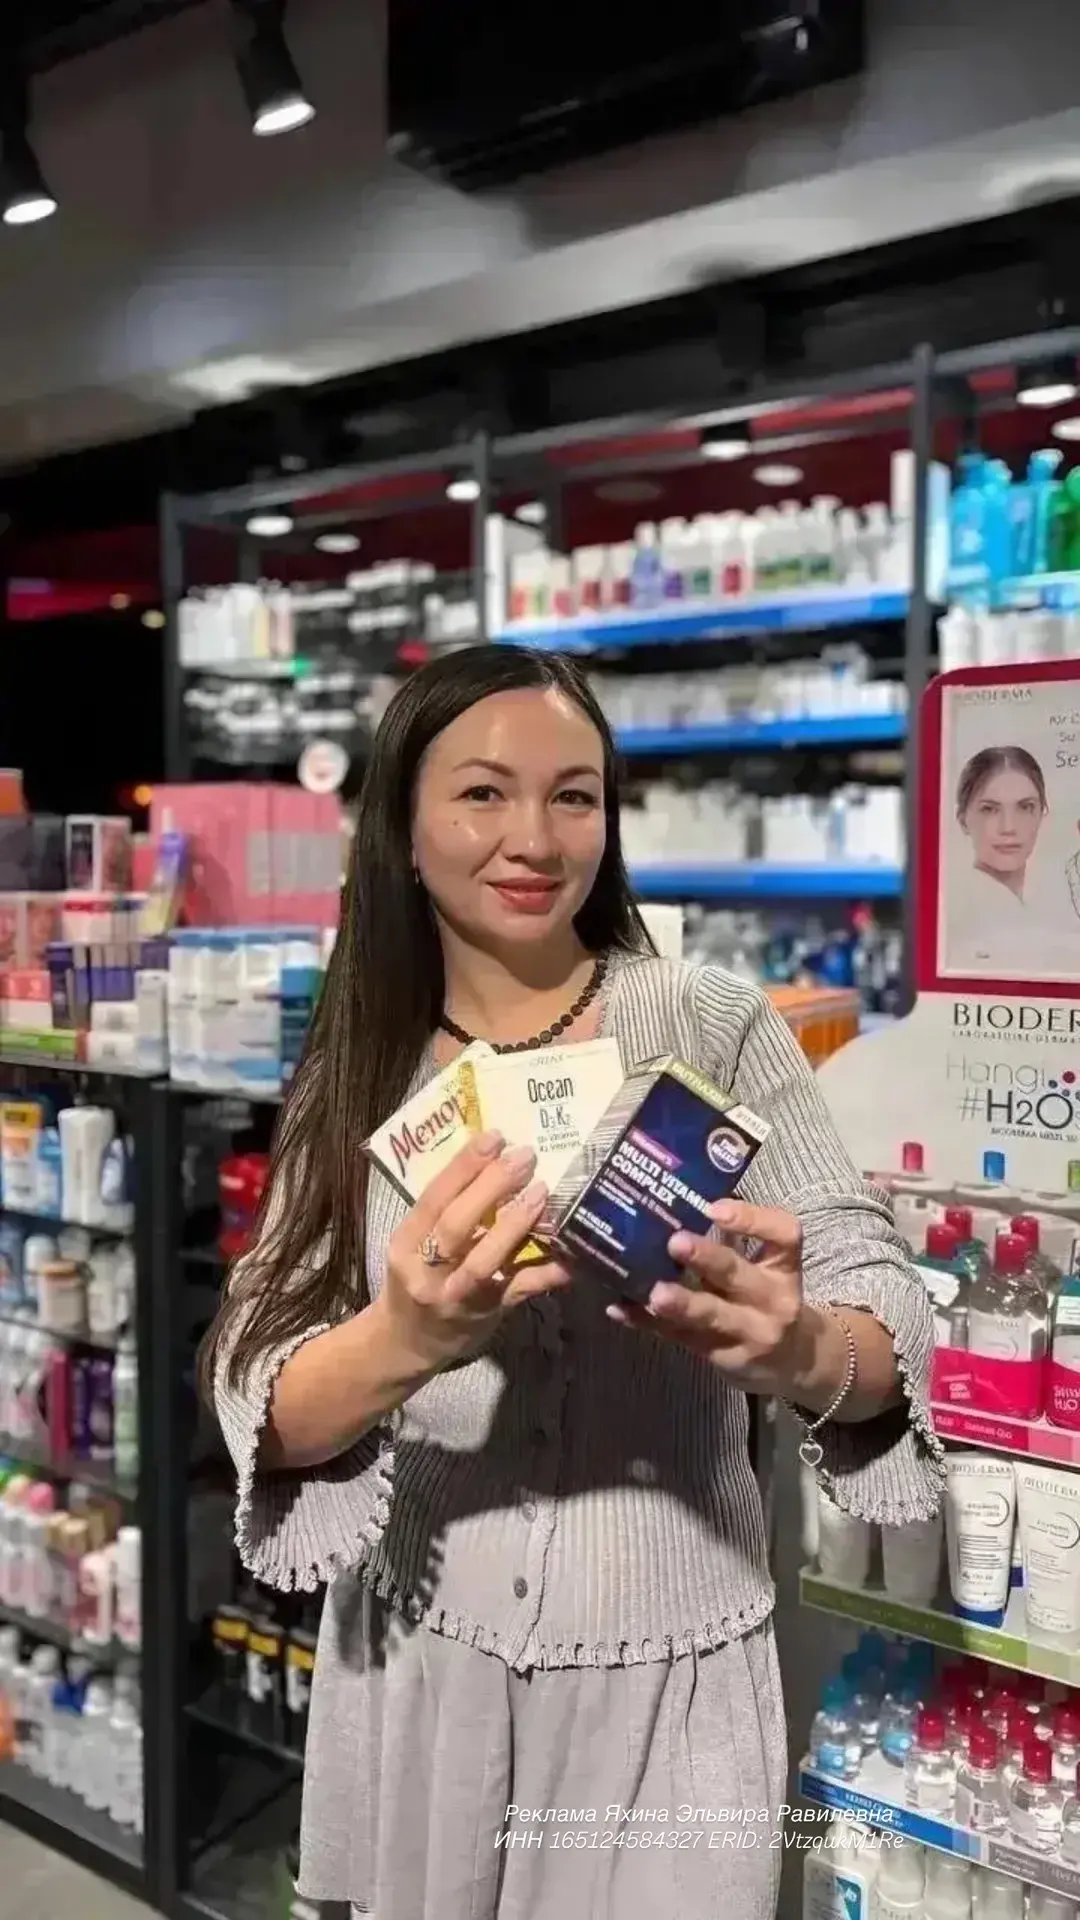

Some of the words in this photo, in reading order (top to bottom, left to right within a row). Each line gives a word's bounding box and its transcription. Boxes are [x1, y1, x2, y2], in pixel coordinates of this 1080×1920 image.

[528, 1078, 573, 1103] Ocean
[618, 1140, 662, 1177] MULTI
[611, 1152, 677, 1207] COMPLEX
